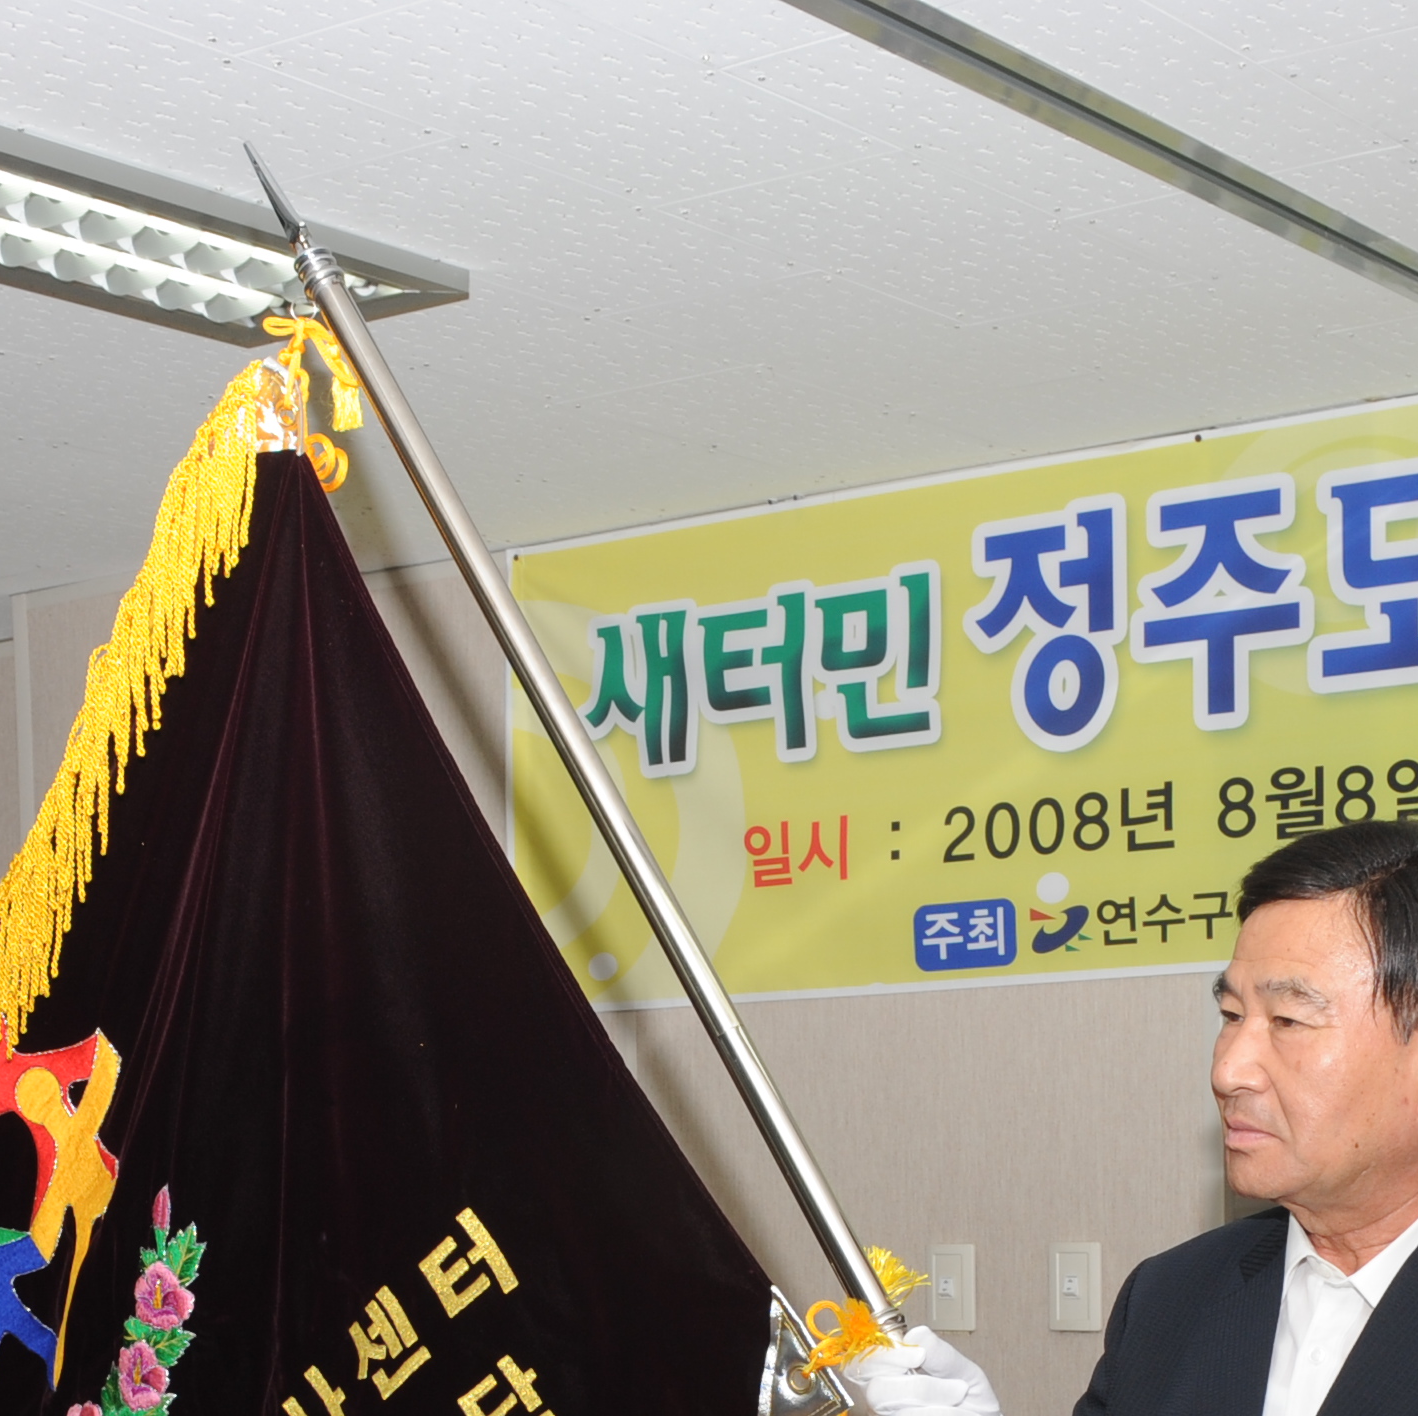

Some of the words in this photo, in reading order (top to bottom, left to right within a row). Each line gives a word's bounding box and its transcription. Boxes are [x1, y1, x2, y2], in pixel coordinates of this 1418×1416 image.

[585, 572, 931, 766] 새터민
[743, 814, 850, 888] 일시
[942, 780, 1176, 864] 2008년
[921, 905, 1006, 961] 주최
